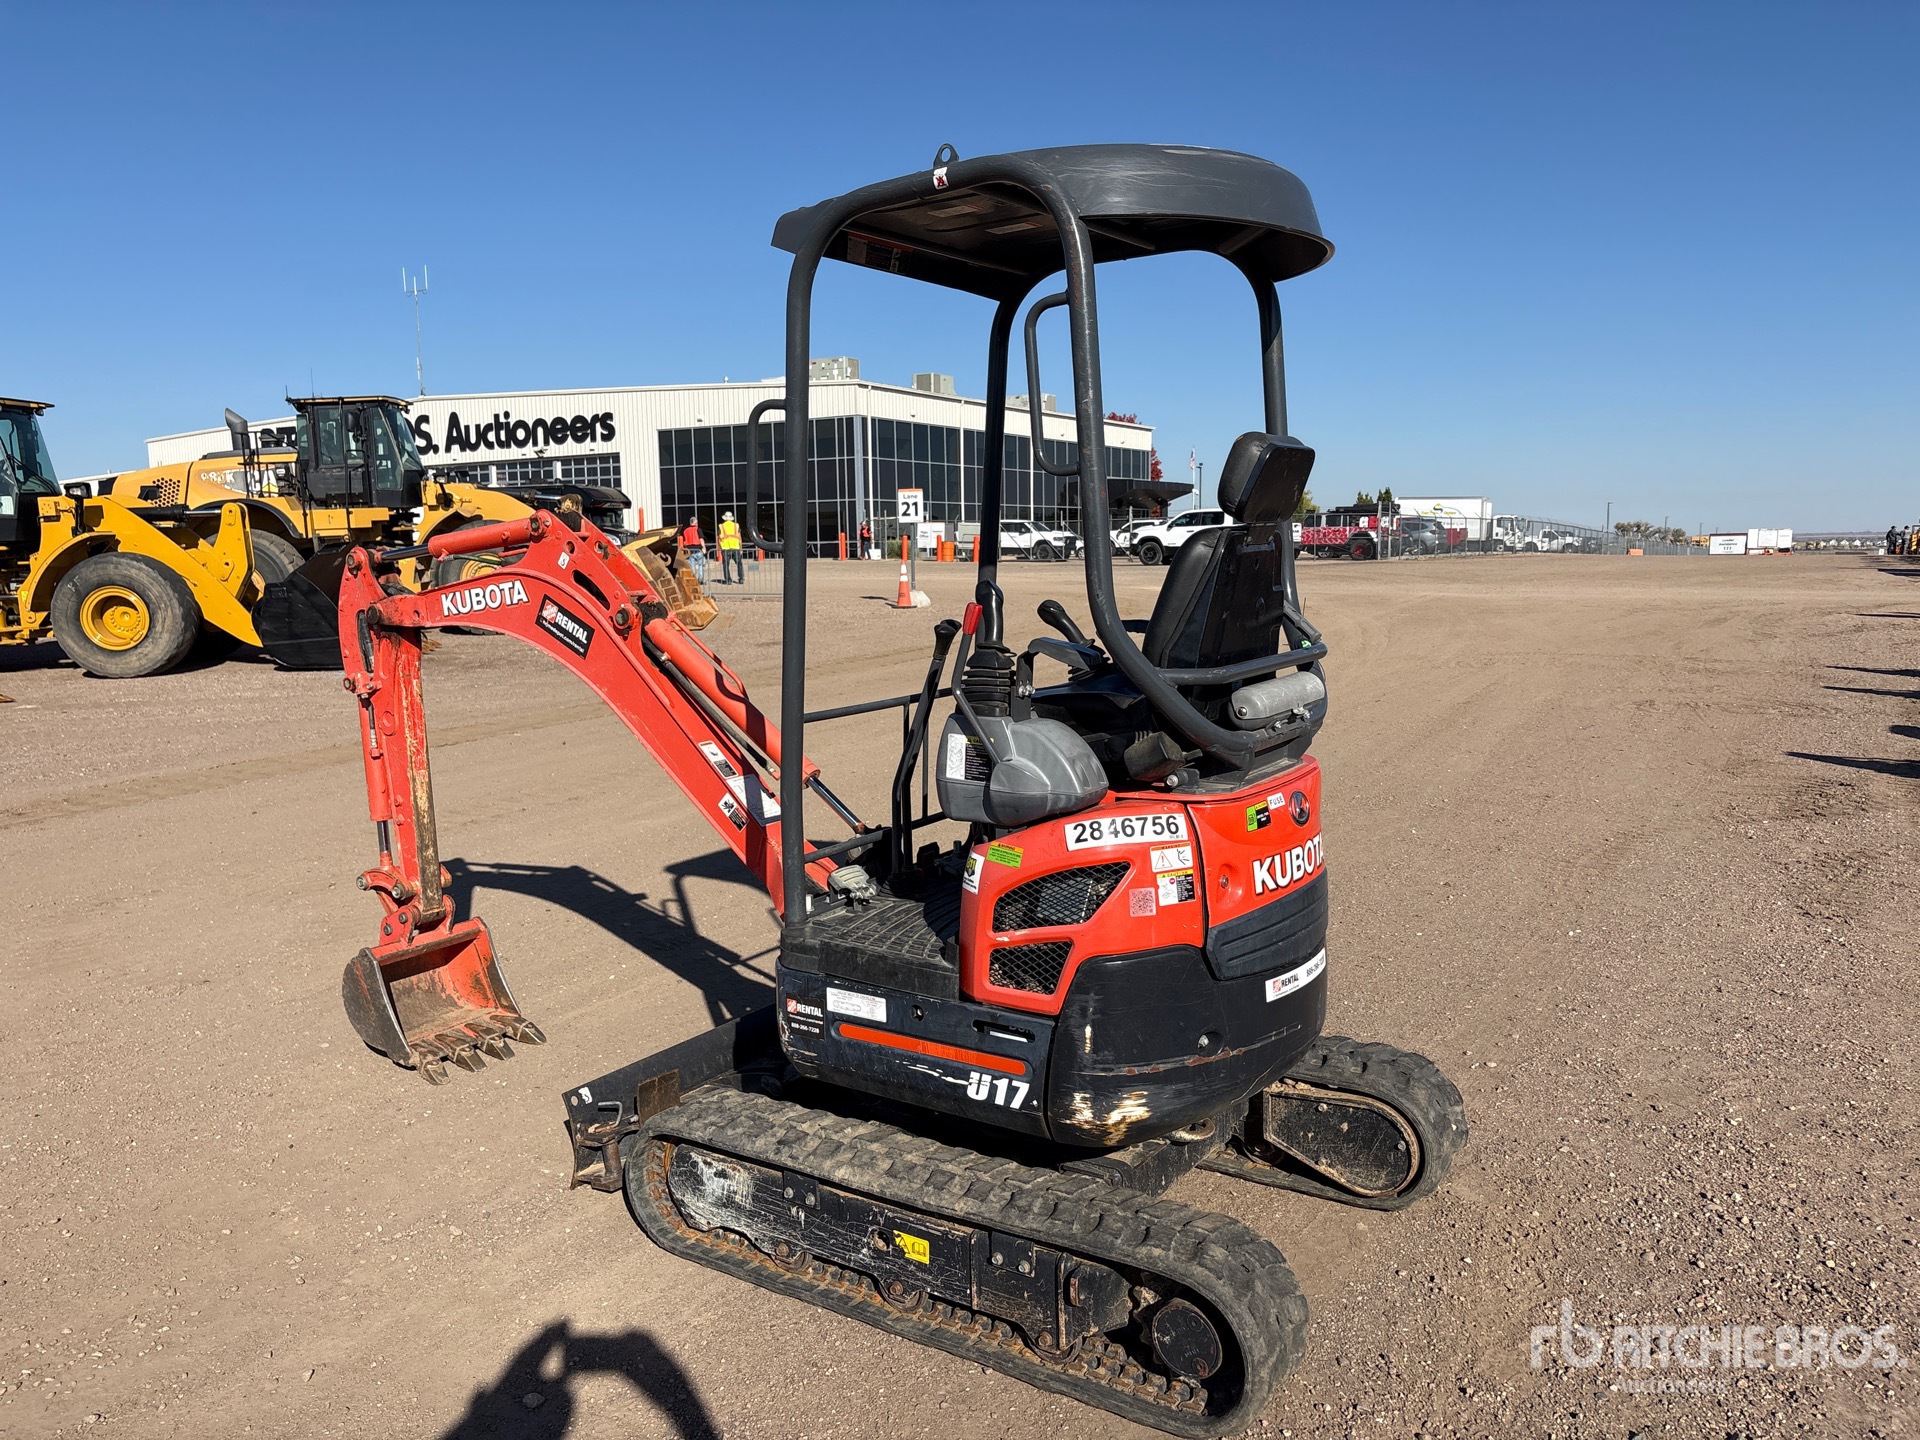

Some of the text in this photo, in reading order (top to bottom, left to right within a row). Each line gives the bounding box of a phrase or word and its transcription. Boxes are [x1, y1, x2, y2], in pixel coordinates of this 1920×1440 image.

[445, 411, 616, 454] Auctioneers
[901, 501, 919, 517] 21
[441, 580, 529, 616] KUBOTA
[555, 611, 588, 644] RENTAL
[1269, 796, 1284, 807] FUSE
[1073, 815, 1180, 844] 2846756
[1281, 973, 1299, 988] RENTAL
[796, 1003, 823, 1017] RENTAL
[966, 1071, 1030, 1109] U17
